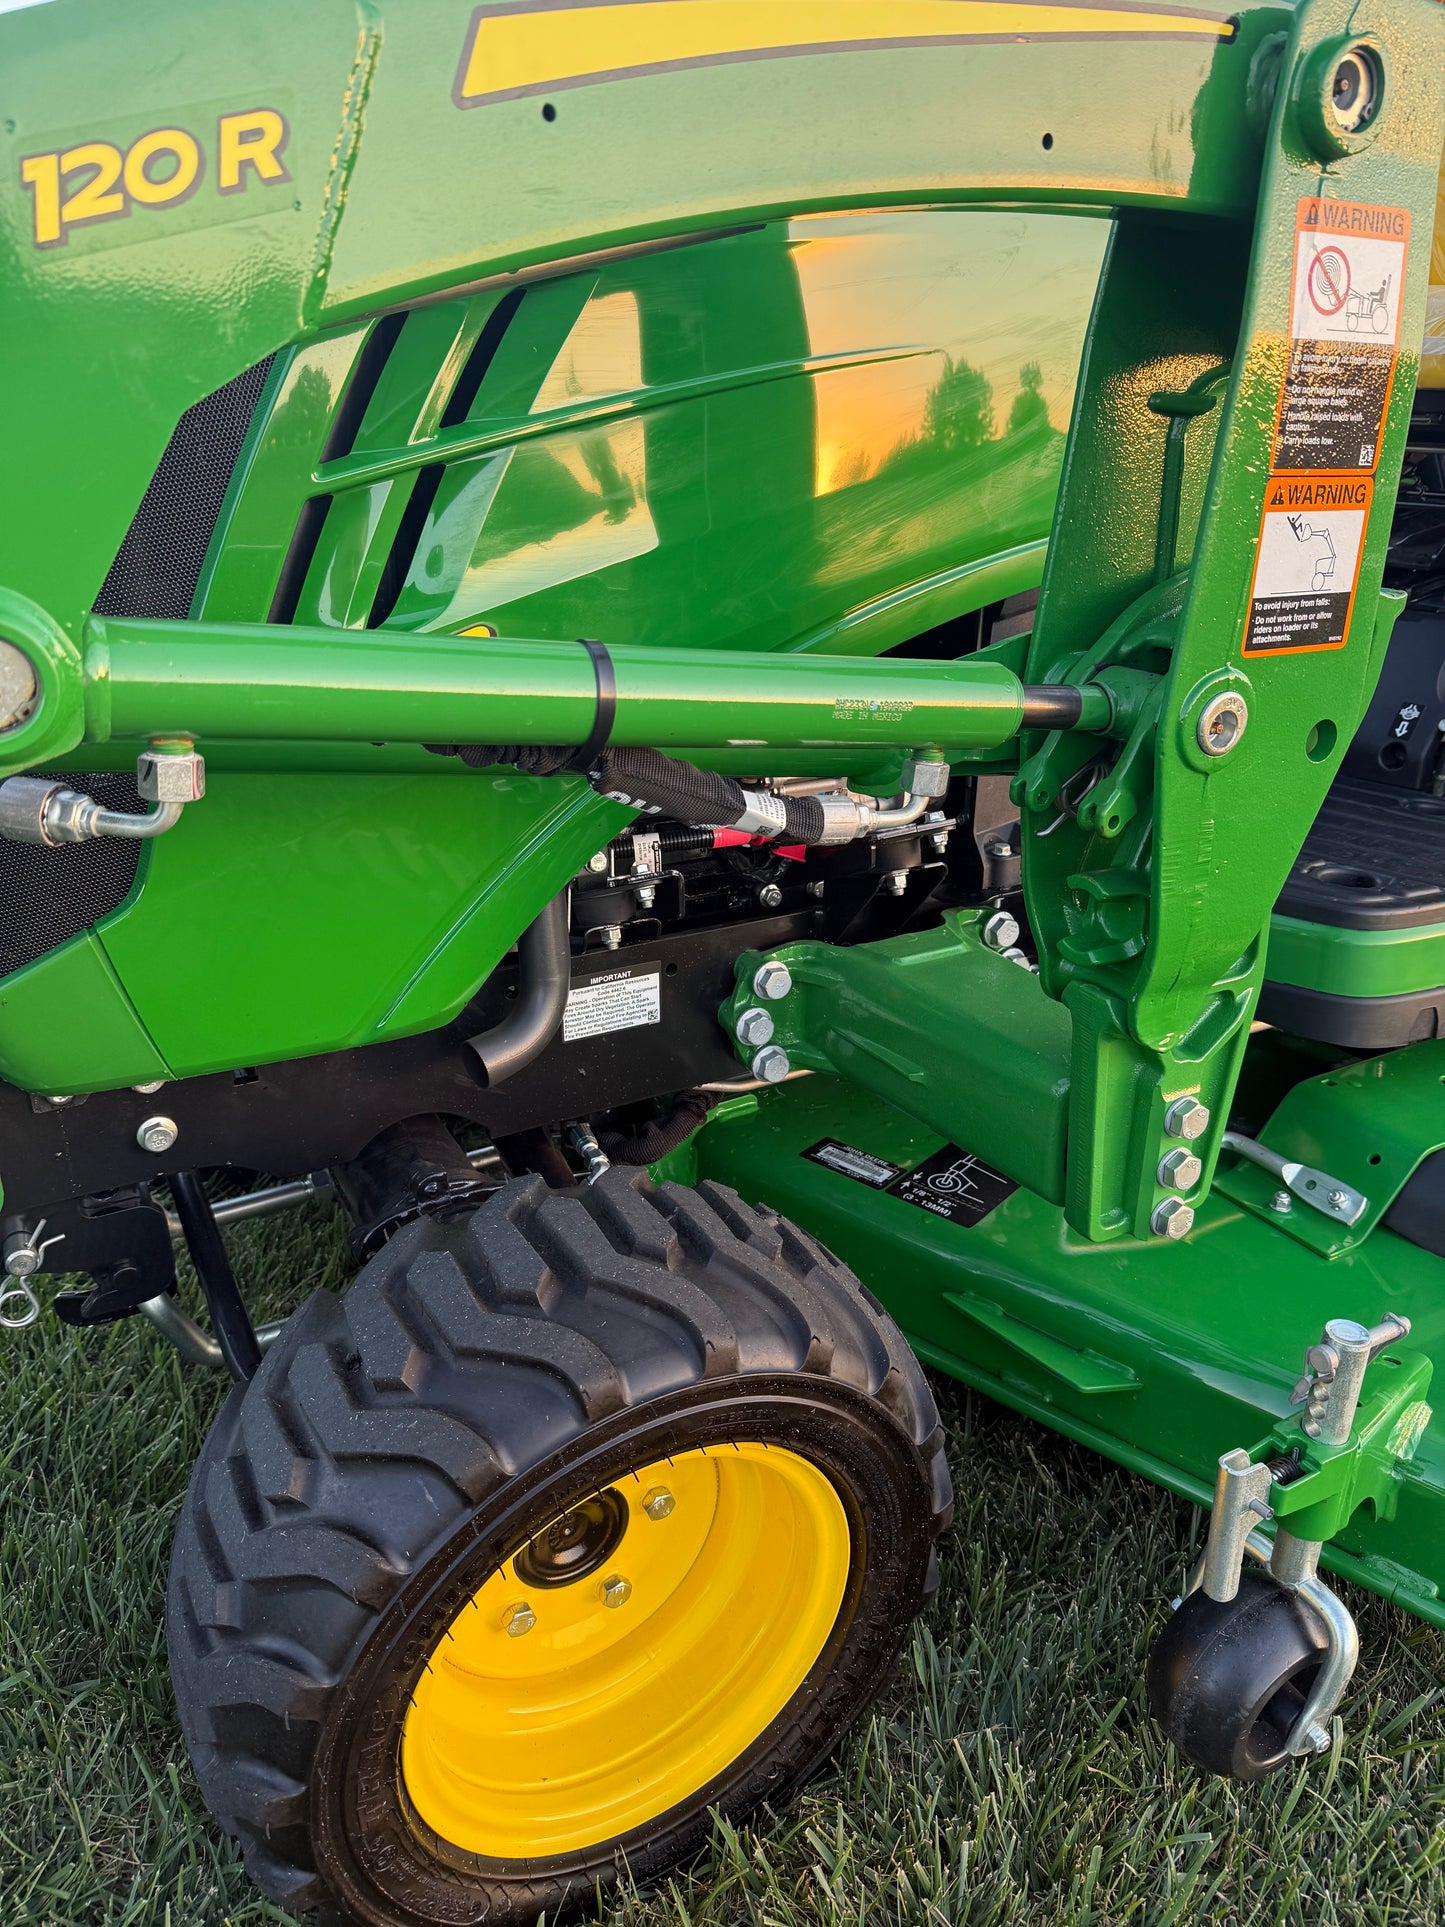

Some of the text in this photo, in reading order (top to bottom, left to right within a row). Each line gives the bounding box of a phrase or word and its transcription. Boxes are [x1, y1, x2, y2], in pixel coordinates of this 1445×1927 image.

[21, 106, 291, 248] 120 R
[1323, 204, 1405, 236] WARNING
[1292, 385, 1301, 393] Do
[1307, 397, 1329, 406] square
[1288, 411, 1310, 420] Handle
[1312, 411, 1331, 420] raised
[1332, 412, 1349, 421] loads
[1286, 423, 1311, 431] caution.
[1284, 436, 1333, 446] Carry loads low.
[1288, 484, 1367, 505] WARNING
[1255, 602, 1262, 610] To
[1263, 601, 1280, 610] avoid
[1282, 601, 1299, 610] injury
[1316, 598, 1330, 606] falls:
[1255, 616, 1264, 624] Do
[1277, 615, 1292, 623] work
[1254, 626, 1272, 634] riders
[1283, 624, 1302, 632] loader
[1252, 634, 1292, 644] attachments.
[832, 711, 902, 721] MADE IN MEXICO
[590, 970, 631, 984] IMPORTANT
[572, 987, 594, 996] Pursuant
[601, 981, 623, 990] California
[624, 976, 649, 985] Resources
[566, 999, 587, 1007] ARNING
[591, 993, 614, 1002] Operation
[632, 984, 657, 994] Equipment
[574, 1003, 590, 1011] Create
[591, 1000, 607, 1008] Sparks
[635, 1000, 655, 1008] Operator
[582, 1017, 601, 1025] Contact
[625, 1007, 646, 1016] Agencies
[593, 1017, 621, 1028] Regulations
[622, 1013, 641, 1022] Relating
[575, 1026, 600, 1036] Prevention
[844, 1146, 864, 1155] JOHN
[865, 1154, 890, 1166] DEERE
[921, 1200, 952, 1216] 13MM)
